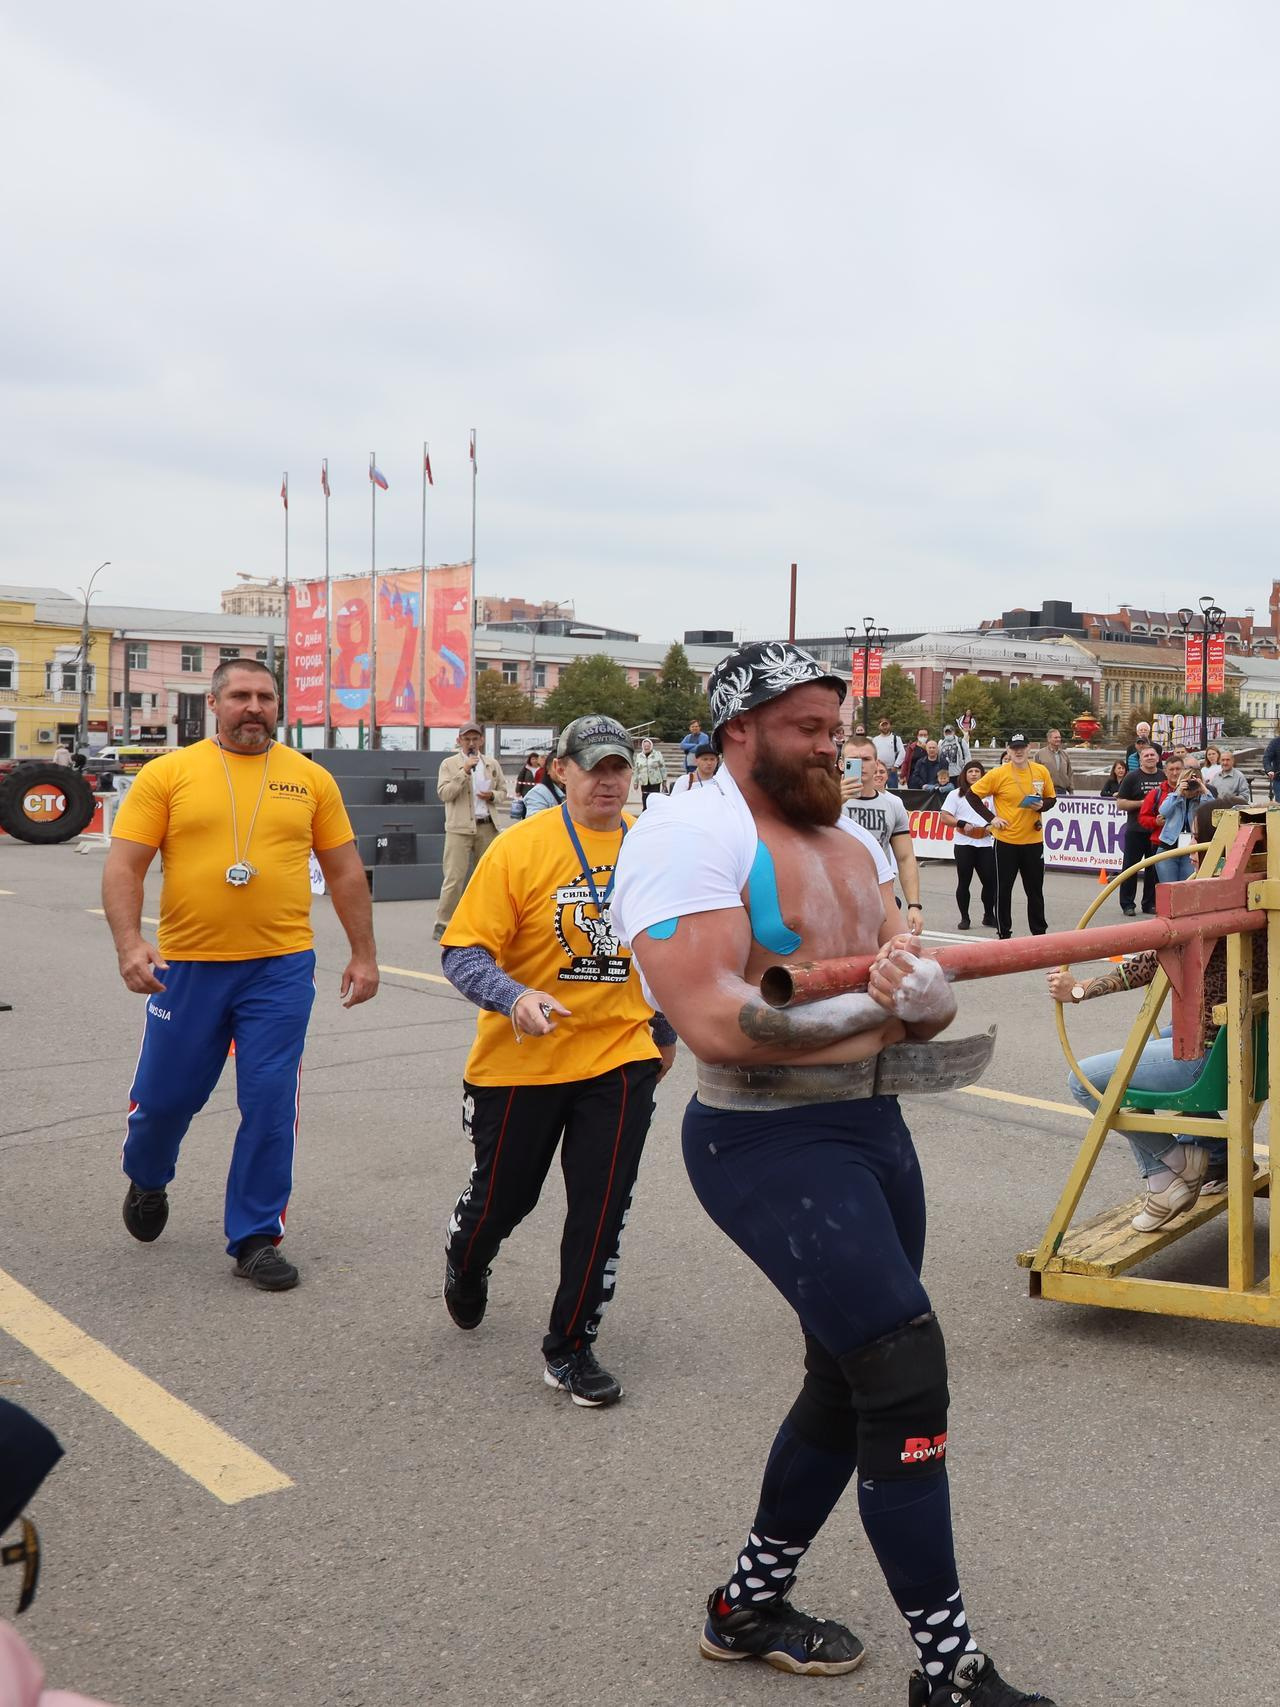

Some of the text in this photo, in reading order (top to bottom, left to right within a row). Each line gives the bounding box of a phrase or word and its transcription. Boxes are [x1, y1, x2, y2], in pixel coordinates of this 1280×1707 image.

[269, 783, 308, 796] СИЛА
[386, 783, 398, 794] 200
[1058, 801, 1104, 815] ФИТНЕС
[377, 838, 388, 848] 240
